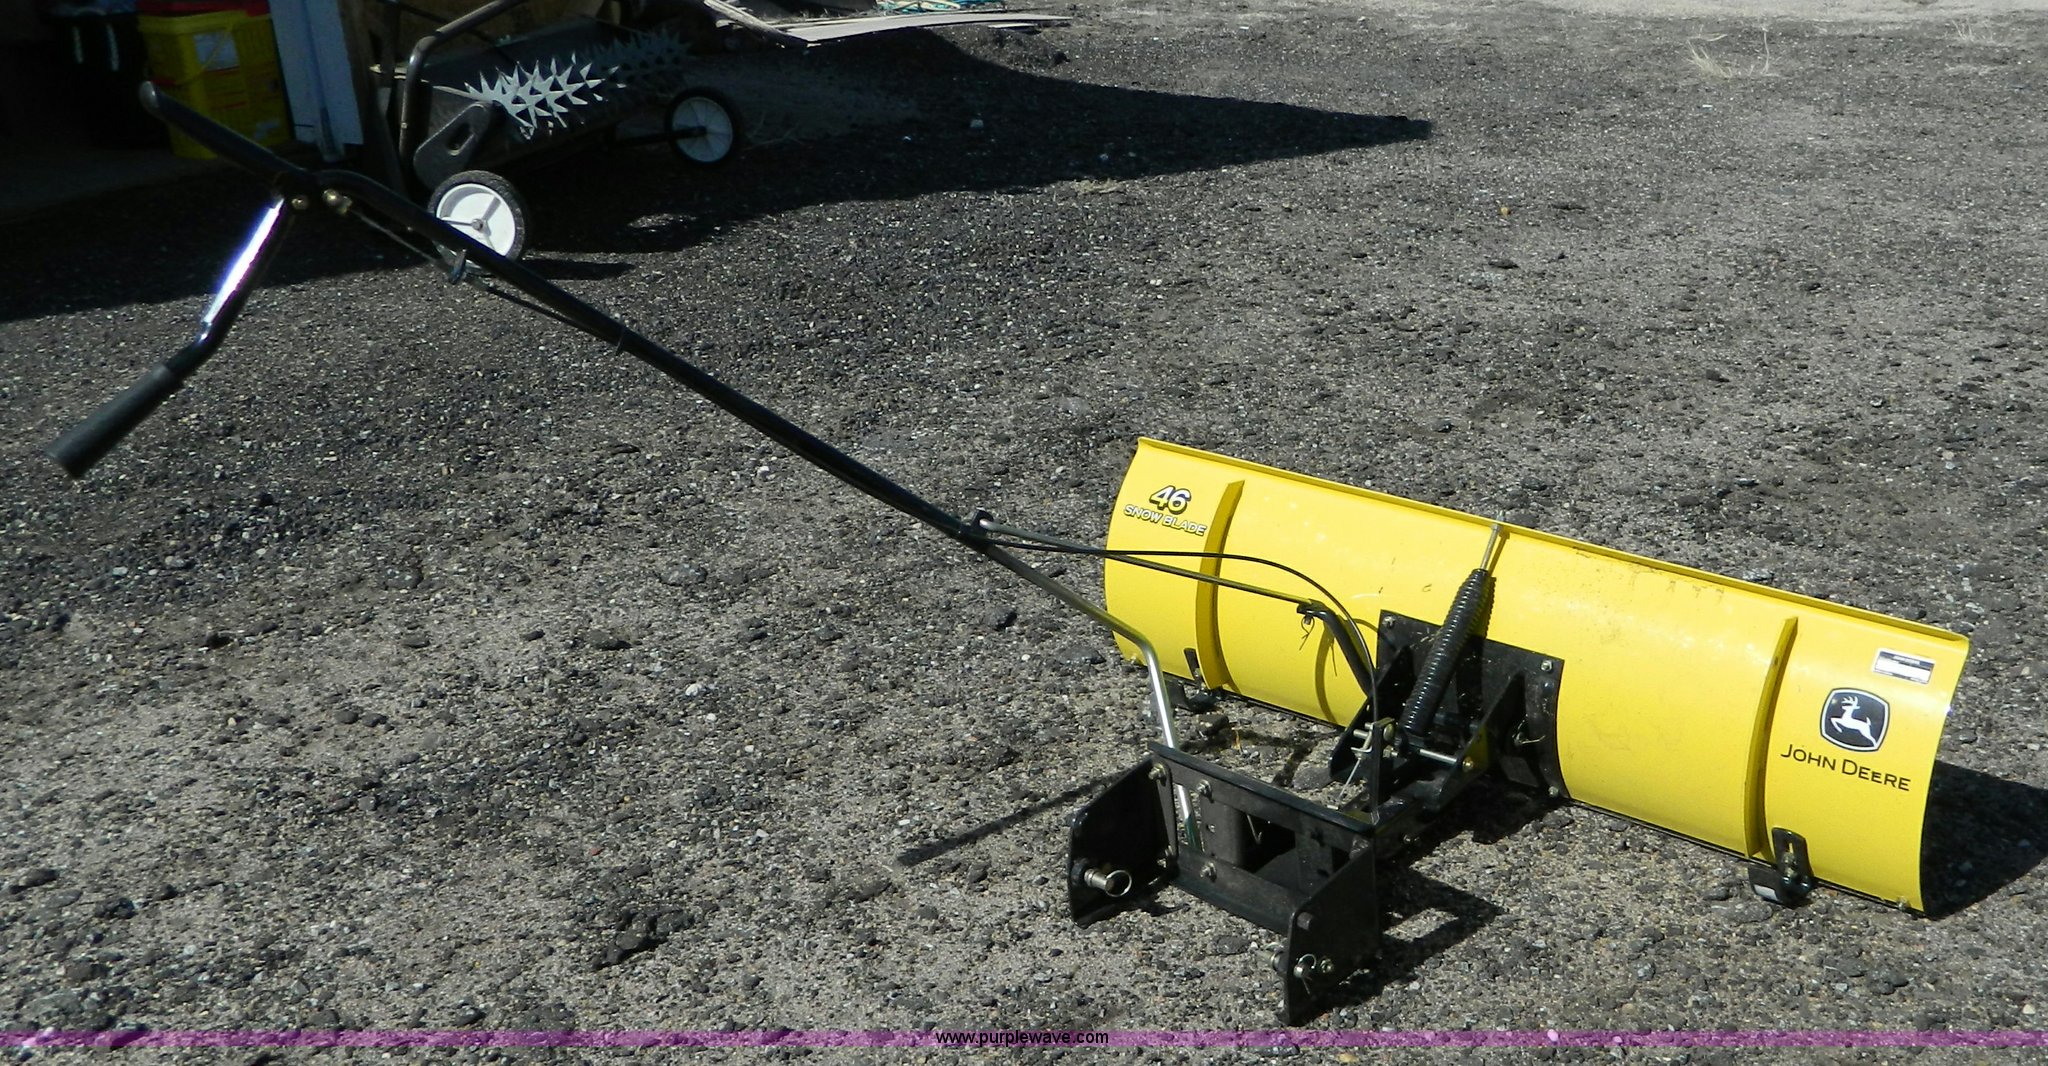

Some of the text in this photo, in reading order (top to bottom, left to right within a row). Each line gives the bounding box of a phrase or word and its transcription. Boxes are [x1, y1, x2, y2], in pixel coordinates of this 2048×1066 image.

[1149, 485, 1191, 515] 46
[1124, 504, 1207, 536] SNOW BLADE
